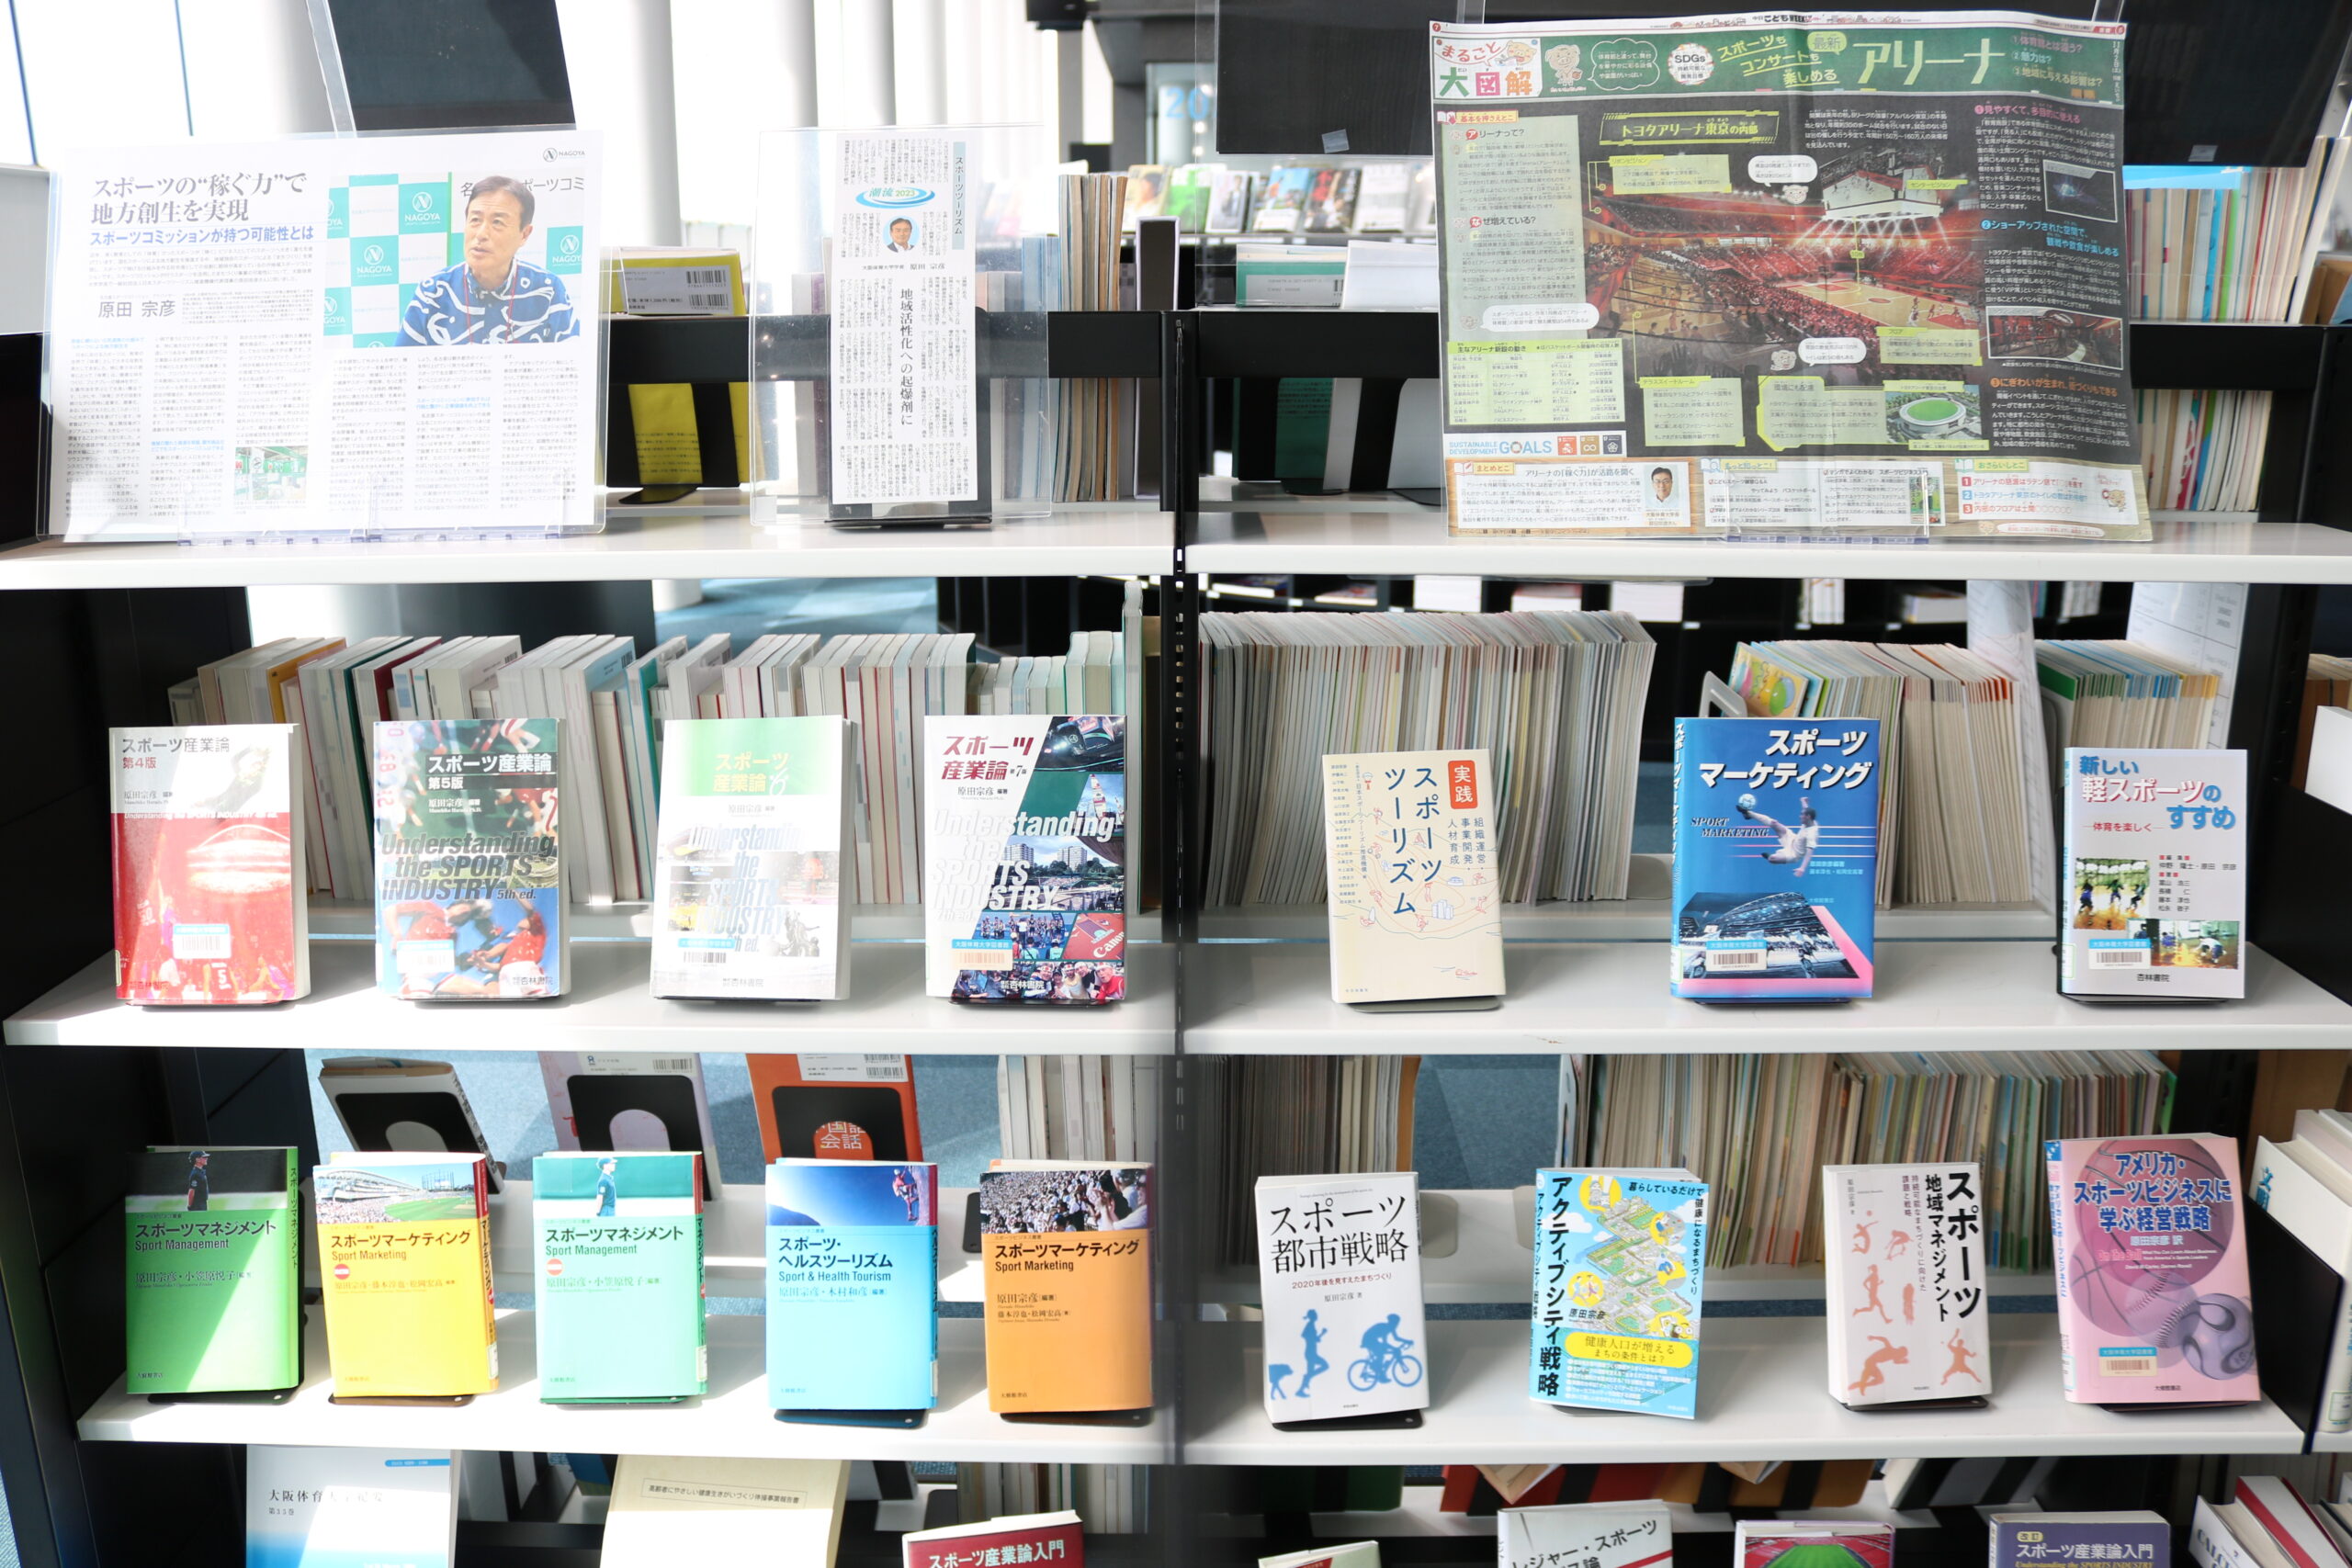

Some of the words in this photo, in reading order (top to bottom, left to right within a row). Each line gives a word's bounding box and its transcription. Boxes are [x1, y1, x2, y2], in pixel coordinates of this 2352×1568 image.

[1442, 41, 1501, 62] まるごと
[1717, 33, 1787, 60] スポーツも
[1814, 36, 1841, 52] 最新
[1675, 54, 1705, 62] SDGs
[1740, 51, 1820, 73] コンサートも
[1853, 38, 2006, 85] アリーナ
[1440, 67, 1532, 97] 大図解
[1783, 67, 1837, 85] 楽しめる
[1167, 88, 1209, 119] 20
[1461, 114, 1513, 123] 基本を押さえとこ
[1623, 122, 1758, 138] トヨタアリーナ東京の内部
[93, 172, 307, 197] スポーツの“稼ぐ力”で
[869, 187, 895, 197] 潮流
[895, 189, 916, 197] 2023
[955, 156, 964, 235] スポーツツーリズム
[91, 198, 249, 225] 地方創生を実現
[404, 212, 441, 222] NAGOYA
[1471, 216, 1536, 227] なぜ増えている?
[90, 225, 314, 246] スポーツコミッションが持つ可能性とは
[356, 265, 393, 274] NAGOYA
[98, 300, 132, 319] 原田
[141, 299, 176, 318] 宗彦
[900, 288, 913, 425] 地域活性化への起爆剤に
[1499, 441, 1553, 454] GOALS
[1476, 464, 1510, 472] まとめとこ
[1978, 461, 2026, 469] おさらいしとこ
[121, 736, 231, 754] スポーツ産業論
[944, 735, 1035, 756] スポーツ
[1766, 728, 1869, 756] スポーツ
[122, 757, 156, 769] 第4版
[428, 753, 552, 774] スポーツ産業論
[714, 751, 791, 772] スポーツ
[942, 760, 1009, 781] 産業論
[2079, 755, 2139, 775] 新しい
[428, 775, 464, 790] 第5版
[713, 773, 766, 794] 産業論
[1453, 764, 1474, 804] 実践
[1700, 761, 1874, 790] マーケティング
[123, 790, 157, 799] 原田宗彦
[957, 786, 994, 796] 原田宗彦
[2082, 776, 2222, 803] 軽スポーツの
[428, 798, 463, 807] 原田宗彦
[933, 808, 1116, 841] Understanding
[1414, 768, 1442, 882] スポーツ
[1691, 817, 1730, 827] SPORT
[2166, 805, 2236, 829] すすめ
[691, 823, 808, 852] Understanding
[1385, 768, 1417, 915] ツーリズム
[1447, 818, 1460, 865] 人材育成
[1702, 828, 1770, 838] MARKETING
[381, 831, 556, 857] Understanding
[963, 836, 1001, 862] the
[1461, 818, 1474, 872] 事業開発・
[1474, 818, 1486, 872] 組織運営・
[395, 853, 432, 877] the
[437, 853, 534, 877] SPORTS
[736, 852, 760, 879] the
[932, 859, 1031, 886] SPORTS
[382, 877, 500, 901] INDUSTRY
[497, 888, 516, 900] 5th
[519, 888, 537, 900] ed.
[708, 878, 781, 906] SPORTS
[933, 884, 1061, 911] INDUSTRY
[696, 906, 789, 935] INDUSTRY
[745, 935, 761, 953] ed.
[956, 941, 1010, 949] 大阪体育大学図書館
[218, 969, 227, 984] 5
[519, 976, 554, 986] 杏林書院
[2136, 973, 2170, 983] 杏林書院
[820, 1133, 862, 1150] 会話
[2115, 1152, 2187, 1177] アメリカ・
[1628, 1181, 1705, 1197] 暮らしているだけで
[2074, 1178, 2233, 1205] スポーツビジネスに
[1271, 1196, 1407, 1236] スポーツ
[2098, 1204, 2212, 1233] 学ぶ経営戦略
[135, 1220, 277, 1238] スポーツマネジメント
[546, 1226, 684, 1243] スポーツマネジメント
[135, 1239, 163, 1252] Sport
[165, 1239, 230, 1252] Management
[331, 1231, 471, 1248] スポーツマーケティング
[779, 1236, 842, 1252] スポーツ・
[995, 1239, 1140, 1259] スポーツマーケティング
[1926, 1174, 1951, 1323] 地域マネジメント
[1947, 1171, 1982, 1319] スポーツ
[332, 1249, 357, 1262] Sport
[359, 1249, 407, 1262] Marketing
[546, 1245, 572, 1257] Sport
[575, 1244, 638, 1257] Management
[1271, 1228, 1409, 1274] 都市戦略
[779, 1254, 894, 1269] ヘルスツーリズム
[995, 1261, 1022, 1274] Sport
[1024, 1260, 1074, 1273] Marketing
[135, 1271, 236, 1283] 原田宗彦・小笠原悦子
[546, 1277, 643, 1288] 原田宗彦・小笠原悦子
[779, 1271, 806, 1283] Sport
[808, 1271, 815, 1282] &
[818, 1271, 851, 1282] Health
[853, 1271, 891, 1282] Tourism
[1291, 1273, 1393, 1290] 2020年後を見すえたまちづくり
[1538, 1177, 1573, 1397] アクティブシティ戦略
[779, 1286, 867, 1297] 原田宗彦・木村和彦
[997, 1293, 1039, 1304] 原田宗彦
[1324, 1292, 1354, 1303] 原田宗彦
[1568, 1307, 1606, 1321] 原田宗彦
[1585, 1336, 1675, 1355] 健康人口が増える
[1594, 1348, 1666, 1364] まちの条件とは?
[929, 1539, 1066, 1568] スポーツ産業論入門
[2016, 1543, 2154, 1560] スポーツ産業論入門
